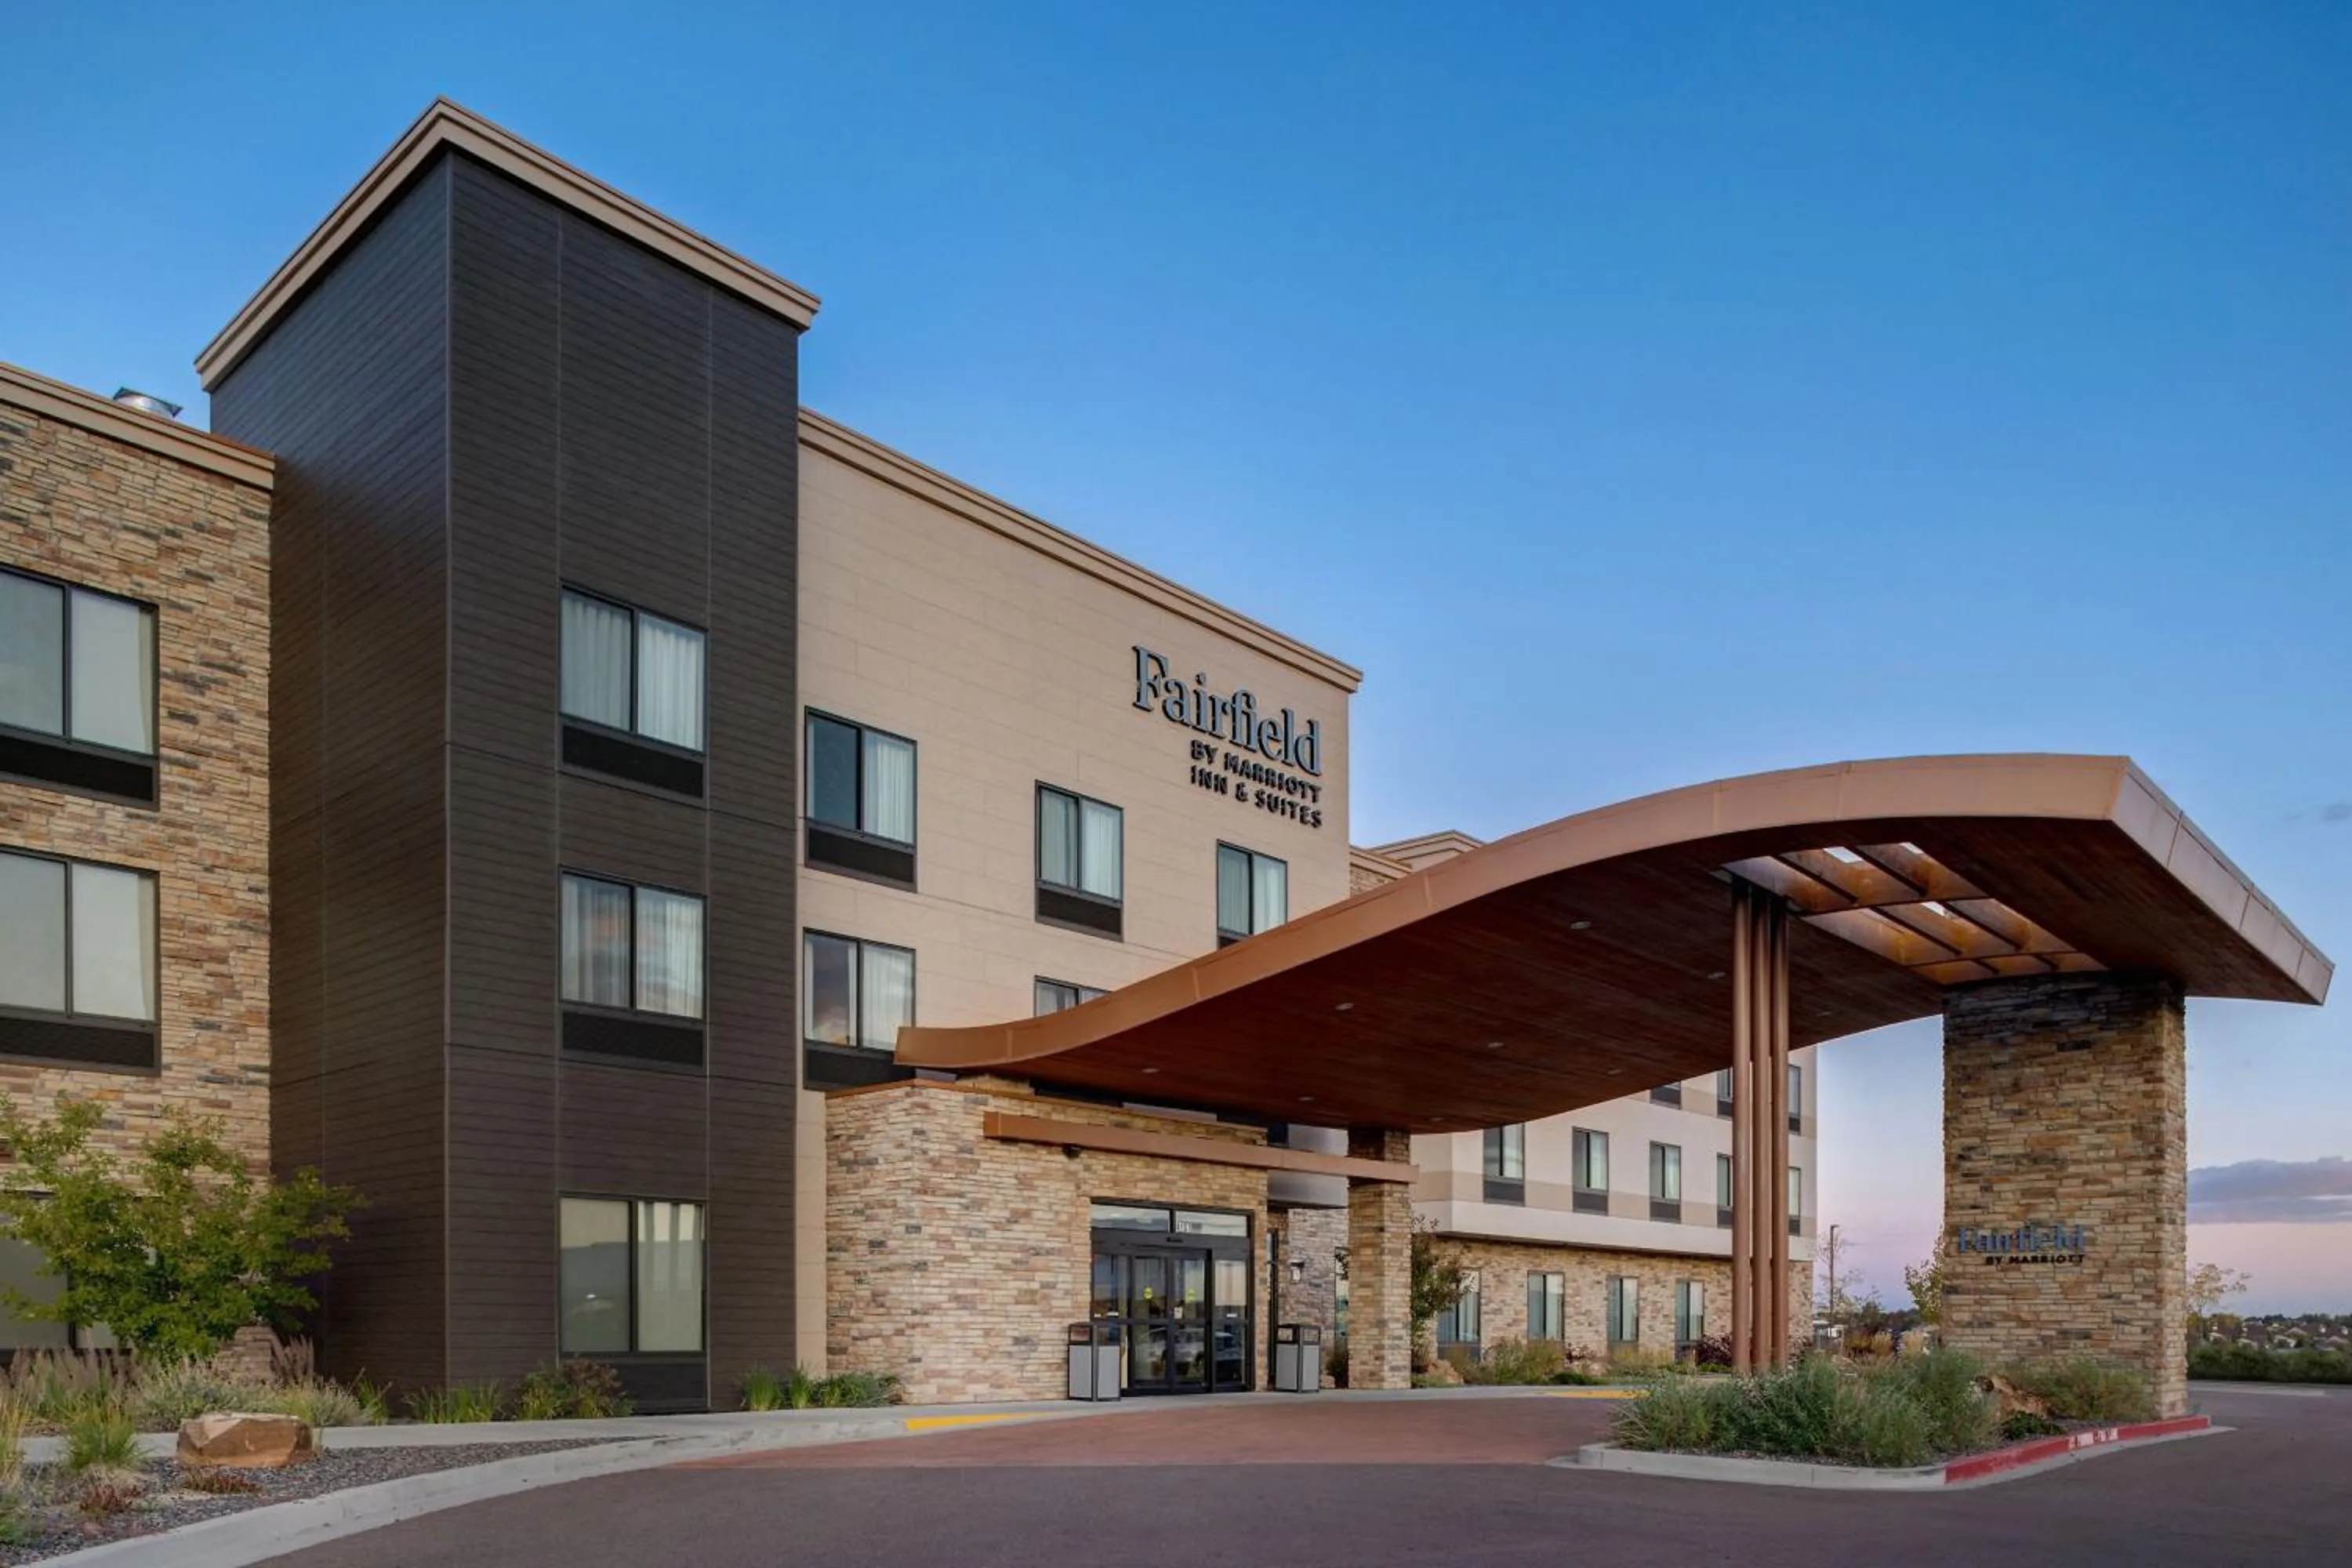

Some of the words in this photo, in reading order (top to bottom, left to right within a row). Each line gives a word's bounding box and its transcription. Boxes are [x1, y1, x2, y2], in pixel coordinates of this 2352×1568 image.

[1132, 644, 1322, 776] Fairfield
[1190, 739, 1218, 764] BY
[1224, 752, 1323, 804] MARRIOTT
[1190, 764, 1229, 795] INN
[1235, 782, 1248, 802] &
[1254, 788, 1323, 829] SUITES
[1958, 1221, 2085, 1254] Fairfield
[1985, 1256, 2001, 1265] BY
[2009, 1254, 2085, 1265] MARRIOTT
